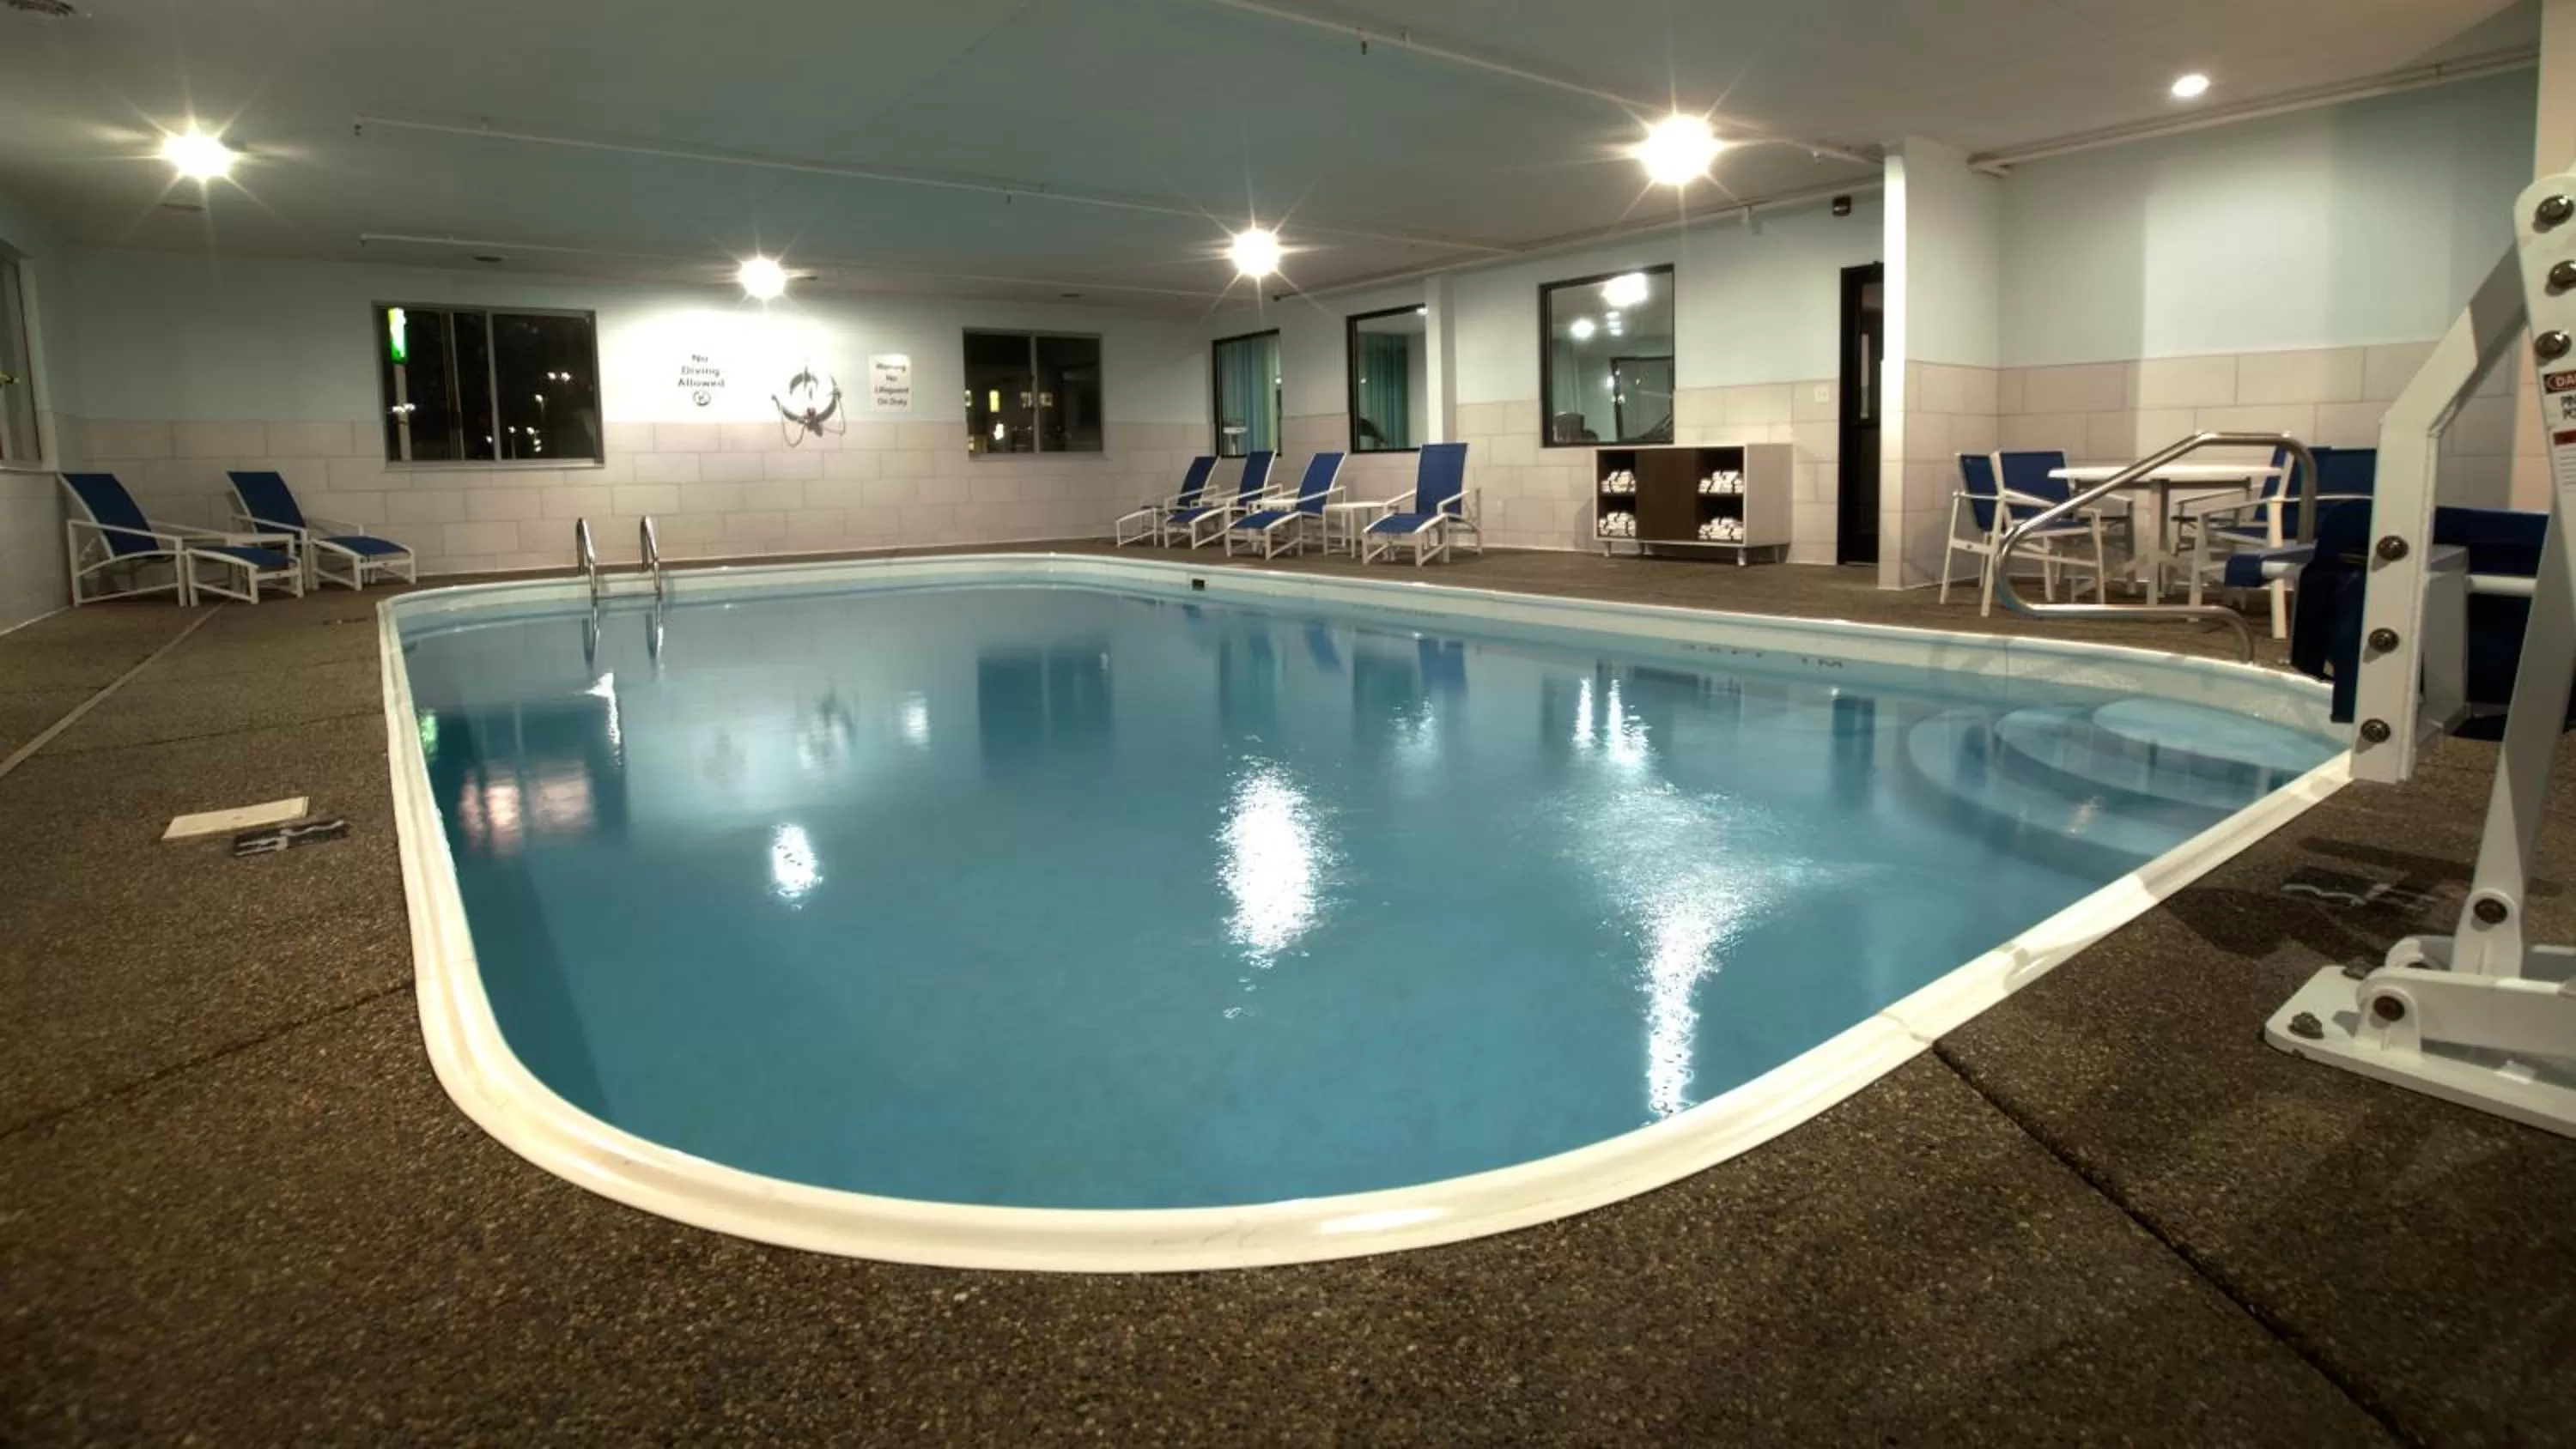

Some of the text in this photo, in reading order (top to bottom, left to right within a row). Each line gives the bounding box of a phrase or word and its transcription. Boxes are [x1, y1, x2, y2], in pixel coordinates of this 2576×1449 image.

[691, 354, 708, 363] No
[681, 365, 720, 378] Diving
[677, 378, 726, 388] Allowed
